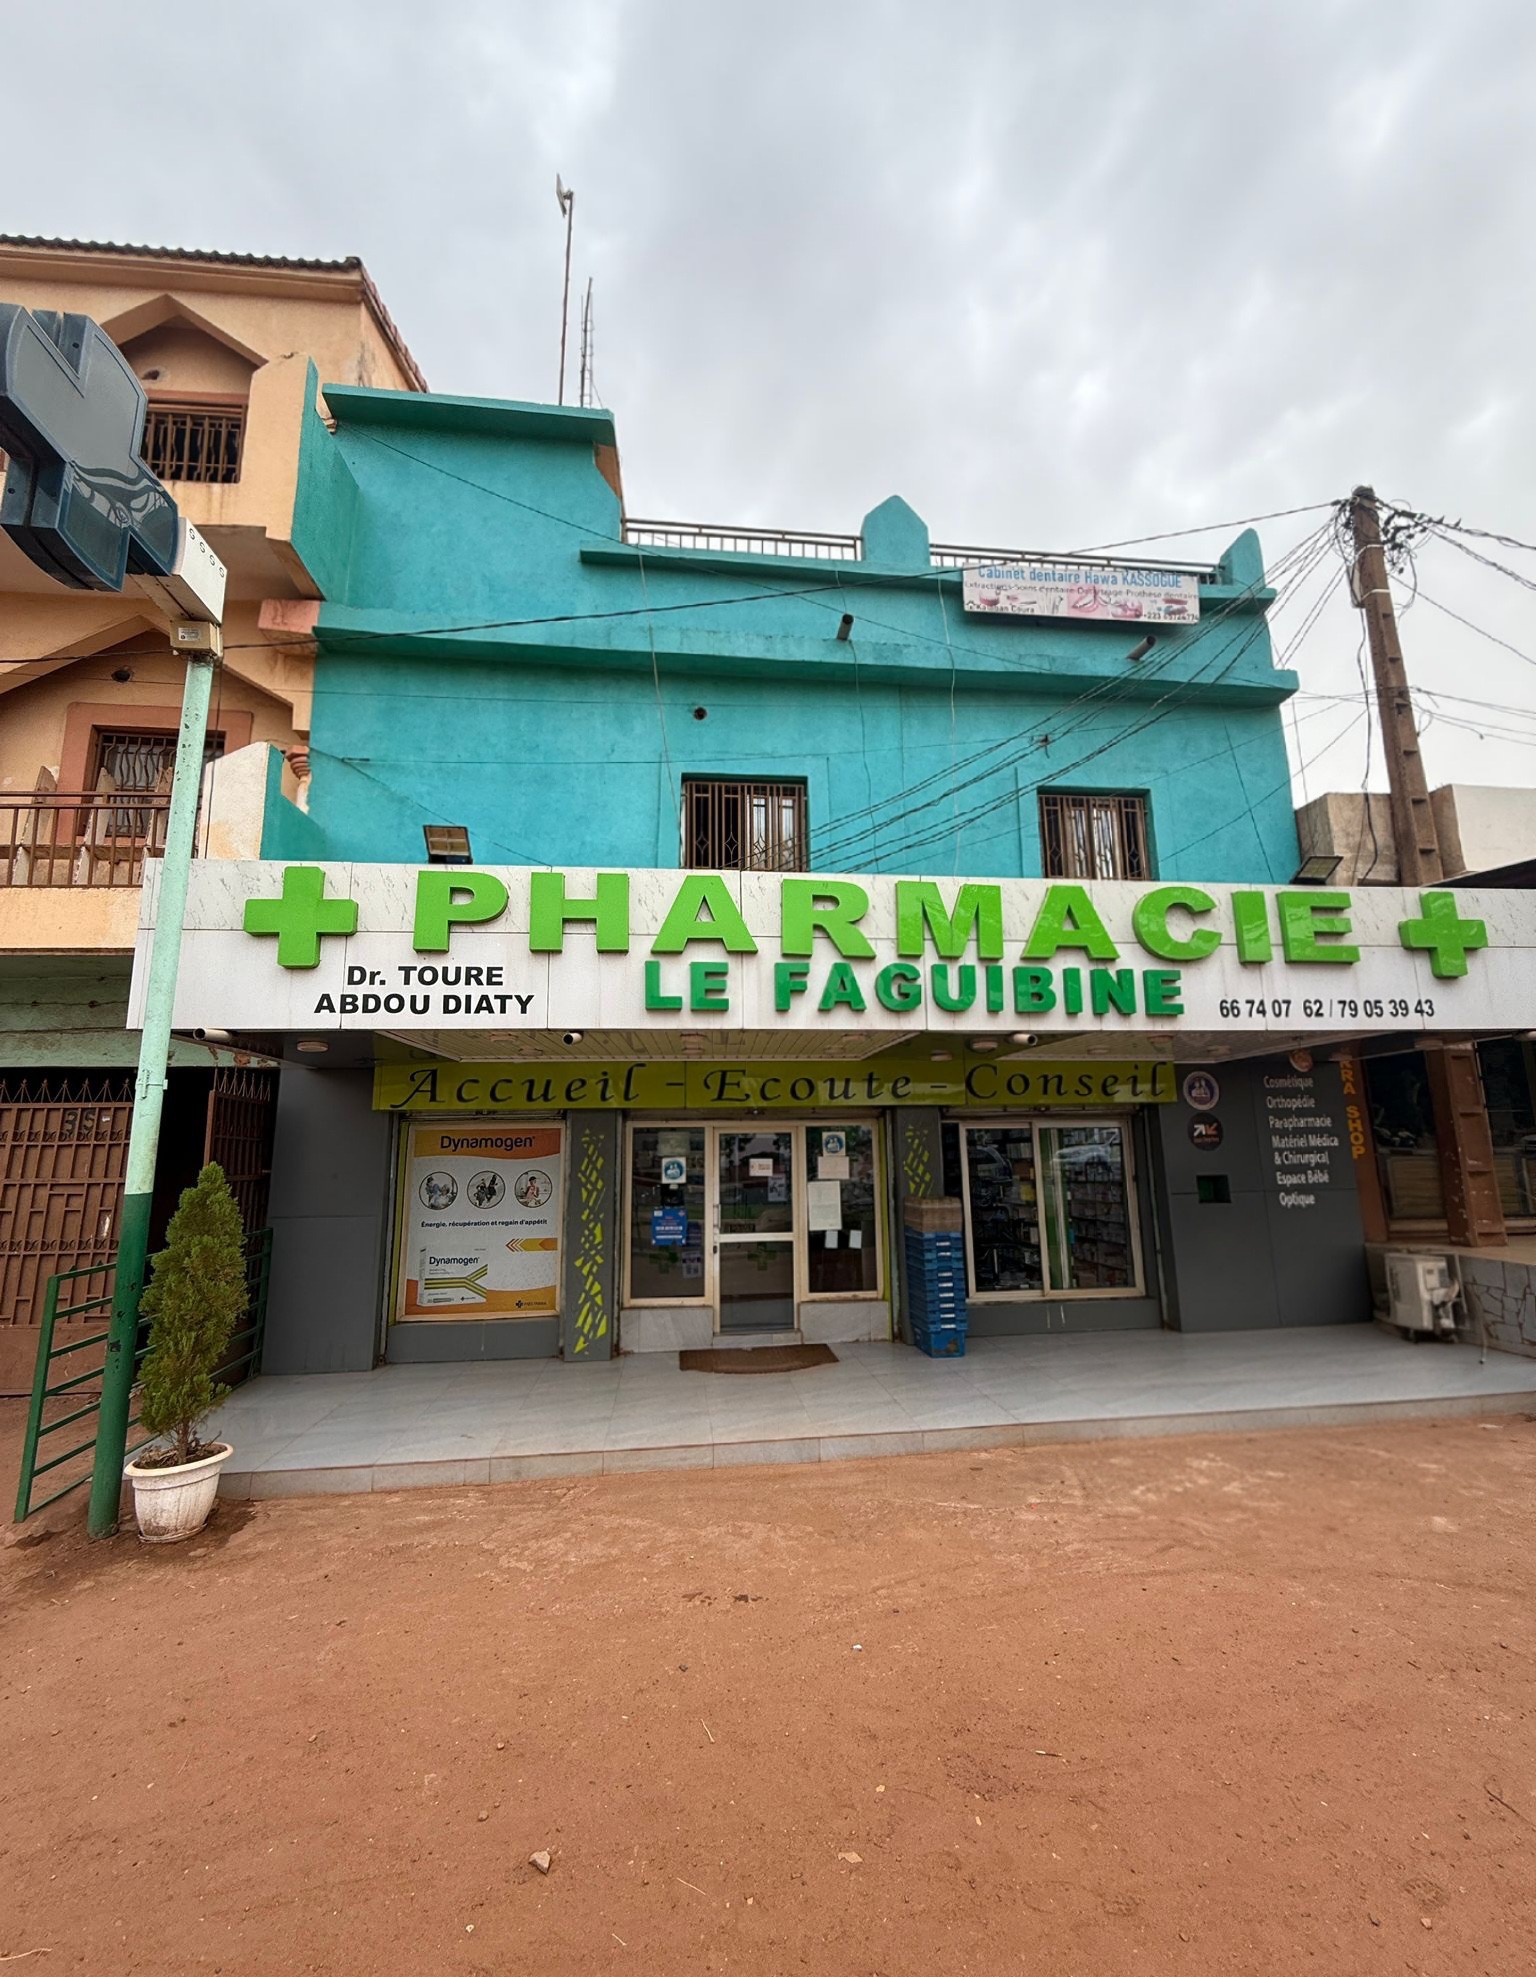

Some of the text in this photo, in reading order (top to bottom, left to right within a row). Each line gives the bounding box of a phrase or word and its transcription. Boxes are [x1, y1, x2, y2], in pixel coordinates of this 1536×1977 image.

[978, 565, 1182, 588] Cabinet dentaire Hawa KASSOGUE
[413, 869, 1361, 964] PHARMACIE
[346, 966, 504, 986] Dr. TOURE
[645, 960, 1184, 1016] LE FAGUIBINE
[314, 993, 535, 1014] ABDOU DIATY
[1219, 999, 1240, 1018] 66
[1245, 999, 1267, 1018] 74
[1272, 999, 1291, 1018] 07
[1303, 999, 1324, 1018] 62
[1337, 999, 1358, 1018] 79
[1363, 999, 1384, 1018] 05
[1388, 999, 1409, 1017] 39
[1414, 999, 1435, 1017] 43
[390, 1062, 647, 1108] Accueil
[703, 1069, 911, 1103] Ecoute
[965, 1061, 1168, 1100] Conseil
[1263, 1075, 1314, 1090] Cosmétique
[1266, 1094, 1316, 1111] Orthopédie
[1268, 1113, 1332, 1131] Parapharmacie
[1271, 1133, 1308, 1149] Matériel
[1346, 1105, 1366, 1159] SHOP
[1274, 1152, 1282, 1165] &
[1276, 1169, 1329, 1187] Espace Bébé
[1278, 1191, 1316, 1208] Optique
[448, 1218, 490, 1229] récupération
[491, 1219, 498, 1227] et
[498, 1219, 519, 1228] regain
[519, 1218, 548, 1227] d'appétit
